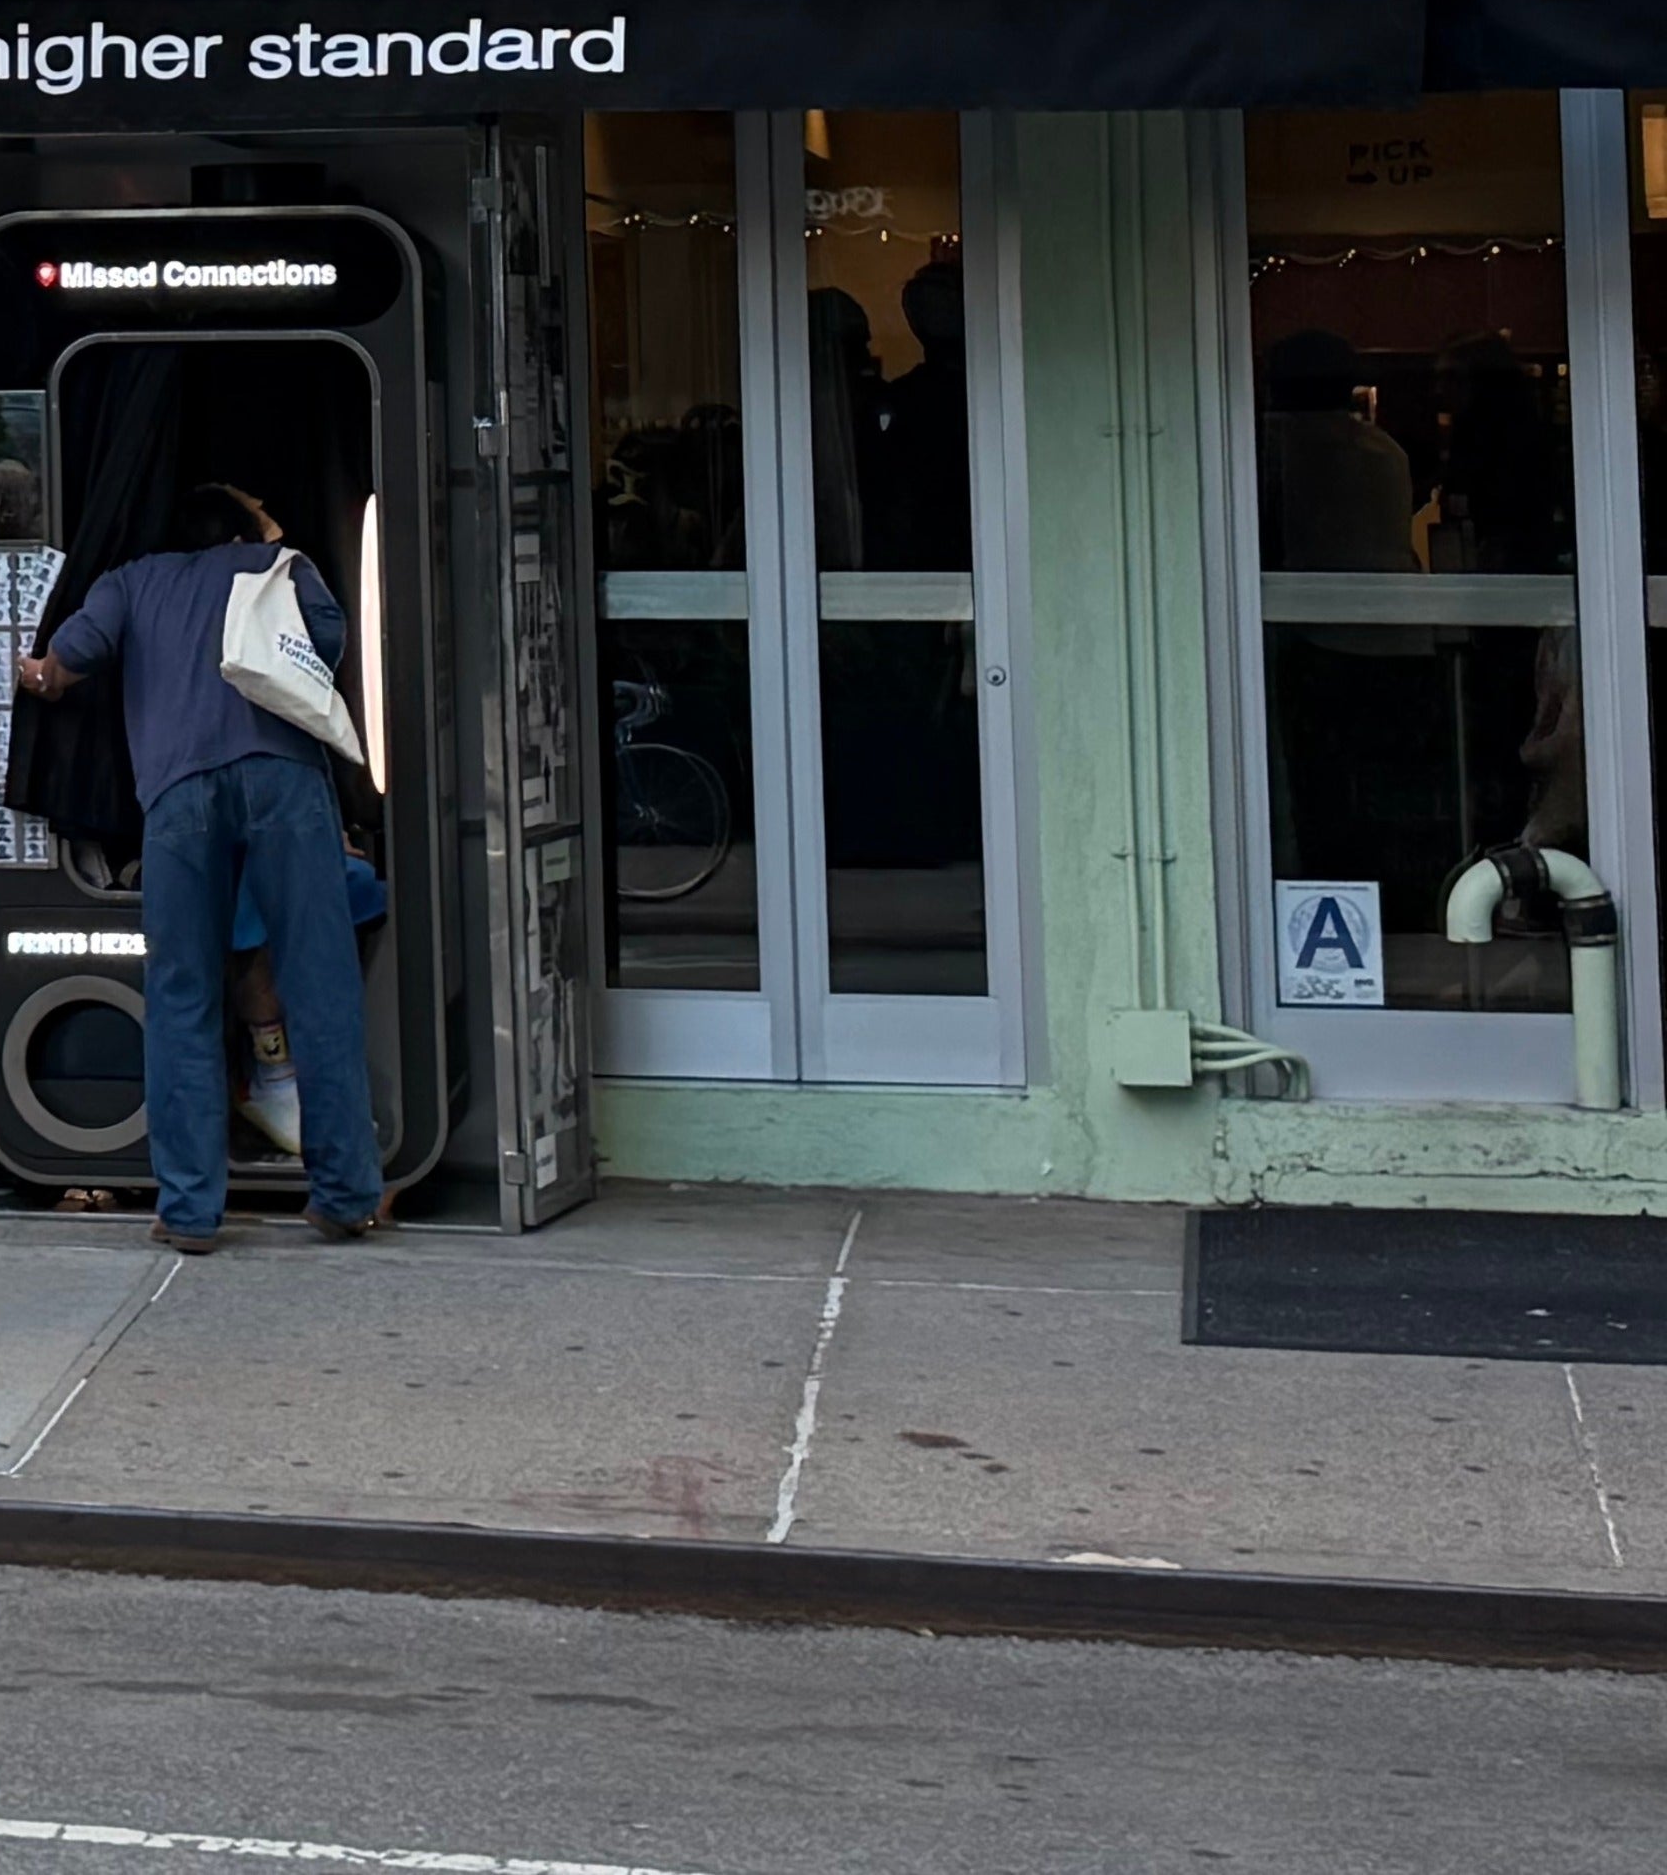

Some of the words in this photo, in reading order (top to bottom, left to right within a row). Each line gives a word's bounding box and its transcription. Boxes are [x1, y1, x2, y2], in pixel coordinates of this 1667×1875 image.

[248, 16, 626, 81] standard
[1349, 139, 1429, 168] PICK
[1388, 164, 1433, 186] UP
[61, 261, 157, 288] Missed
[163, 259, 337, 287] Connections
[1295, 896, 1364, 969] A
